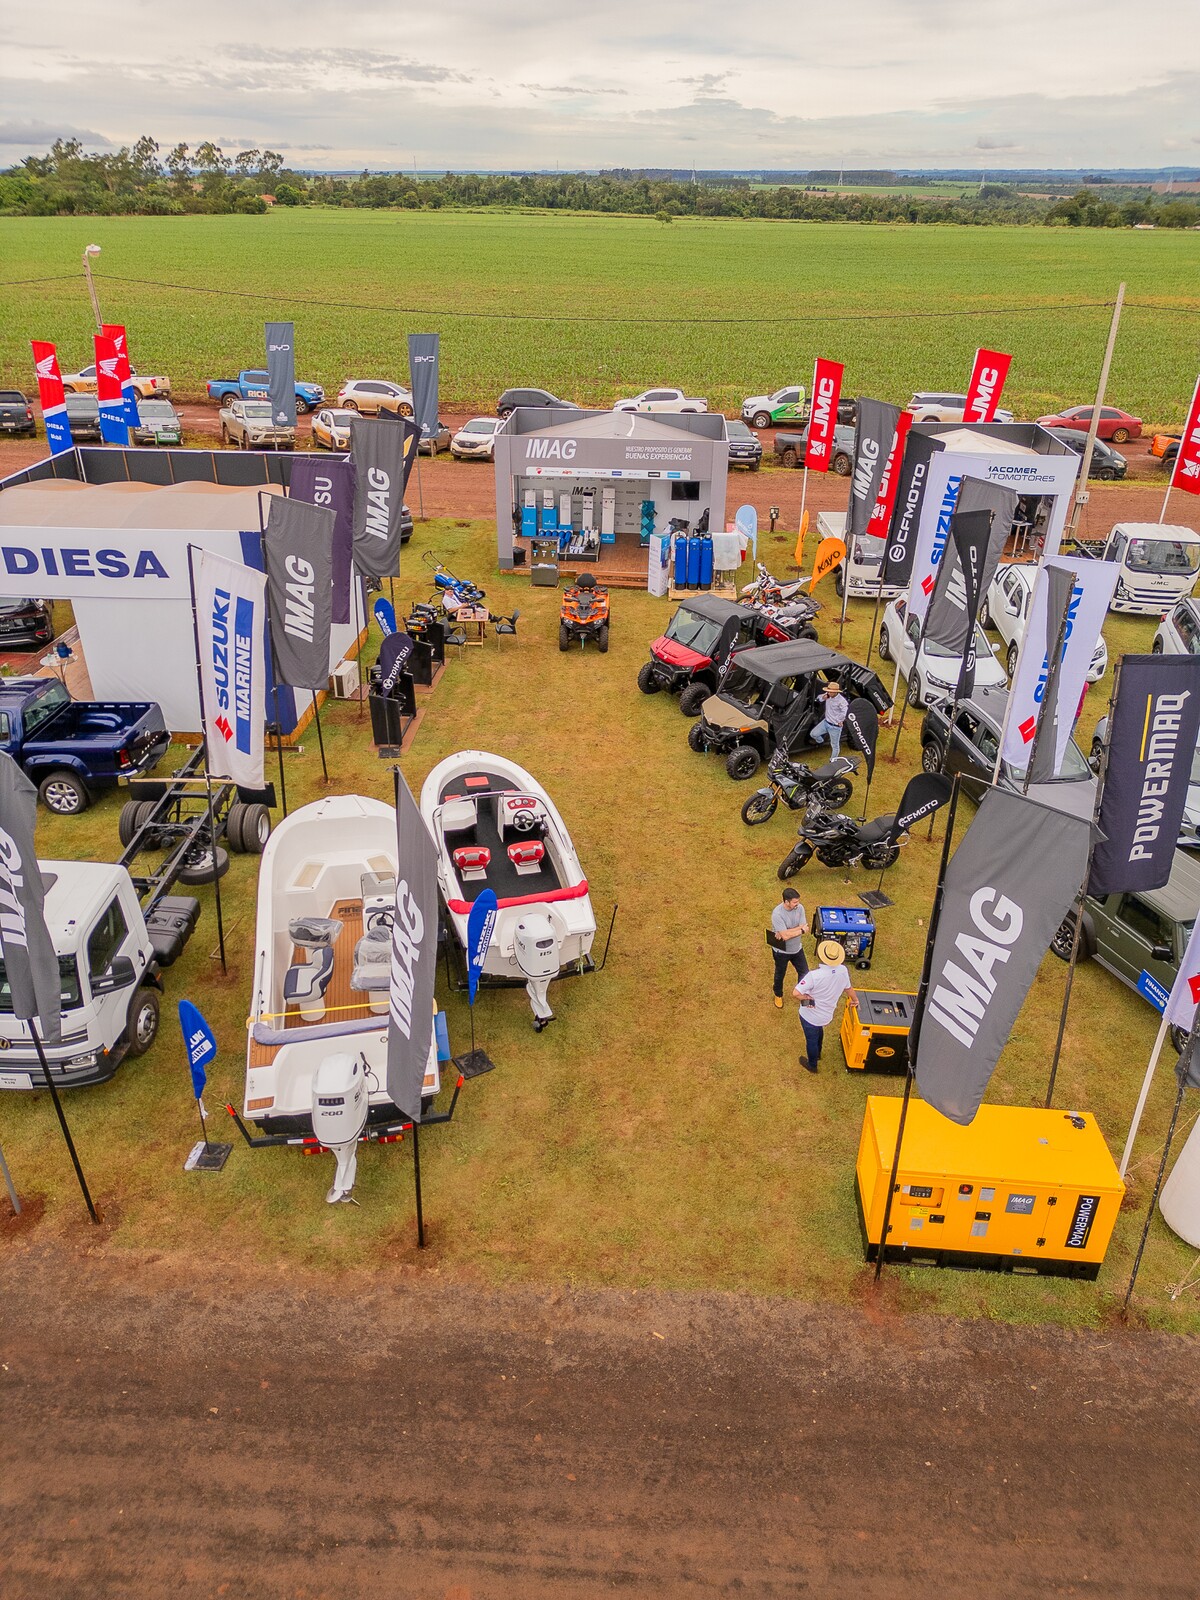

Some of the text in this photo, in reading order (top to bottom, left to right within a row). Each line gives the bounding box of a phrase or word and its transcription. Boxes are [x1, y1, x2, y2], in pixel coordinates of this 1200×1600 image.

[101, 412, 125, 423] DIESA
[814, 378, 834, 437] JMC
[971, 367, 998, 422] JMC
[525, 438, 578, 460] IMAG
[852, 438, 880, 500] IMAG
[984, 473, 1056, 482] UTOMOTORES
[366, 467, 390, 540] IMAG
[896, 462, 926, 543] CFMOTO
[930, 475, 960, 565] SUZUKI
[1, 546, 170, 579] DIESA
[284, 555, 314, 642] IMAG
[212, 588, 232, 710] SUZUKI
[235, 634, 250, 721] MARINE
[388, 646, 410, 678] TOHATSU
[852, 720, 872, 755] CFMOTO
[1128, 689, 1191, 862] POWERMAQ
[390, 879, 425, 1040] IMAG
[477, 910, 492, 952] SUZUKI
[928, 886, 1024, 1048] IMAG
[1068, 1198, 1094, 1246] POWERMAQ
